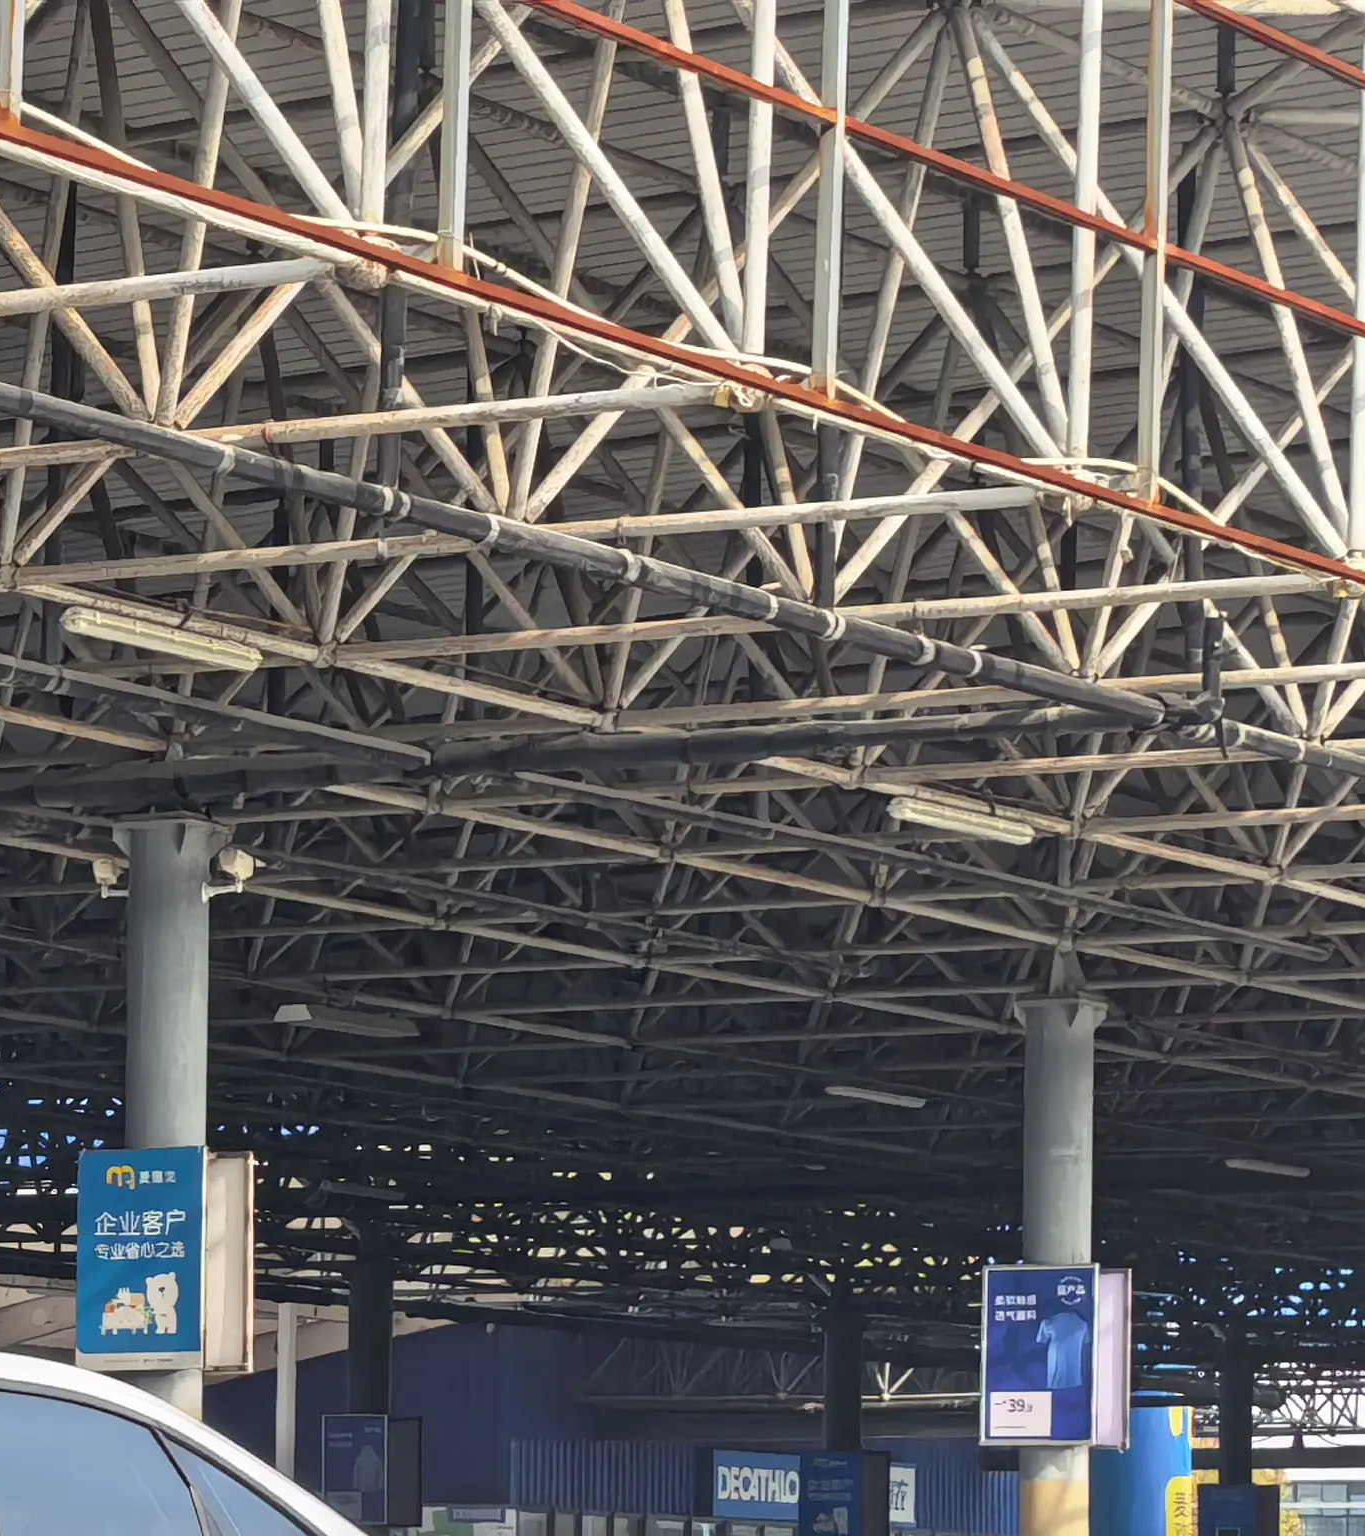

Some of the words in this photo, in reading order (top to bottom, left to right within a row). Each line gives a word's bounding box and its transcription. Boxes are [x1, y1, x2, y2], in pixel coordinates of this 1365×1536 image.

[94, 1209, 186, 1236] 企业客户
[94, 1241, 186, 1260] 专业省心之选
